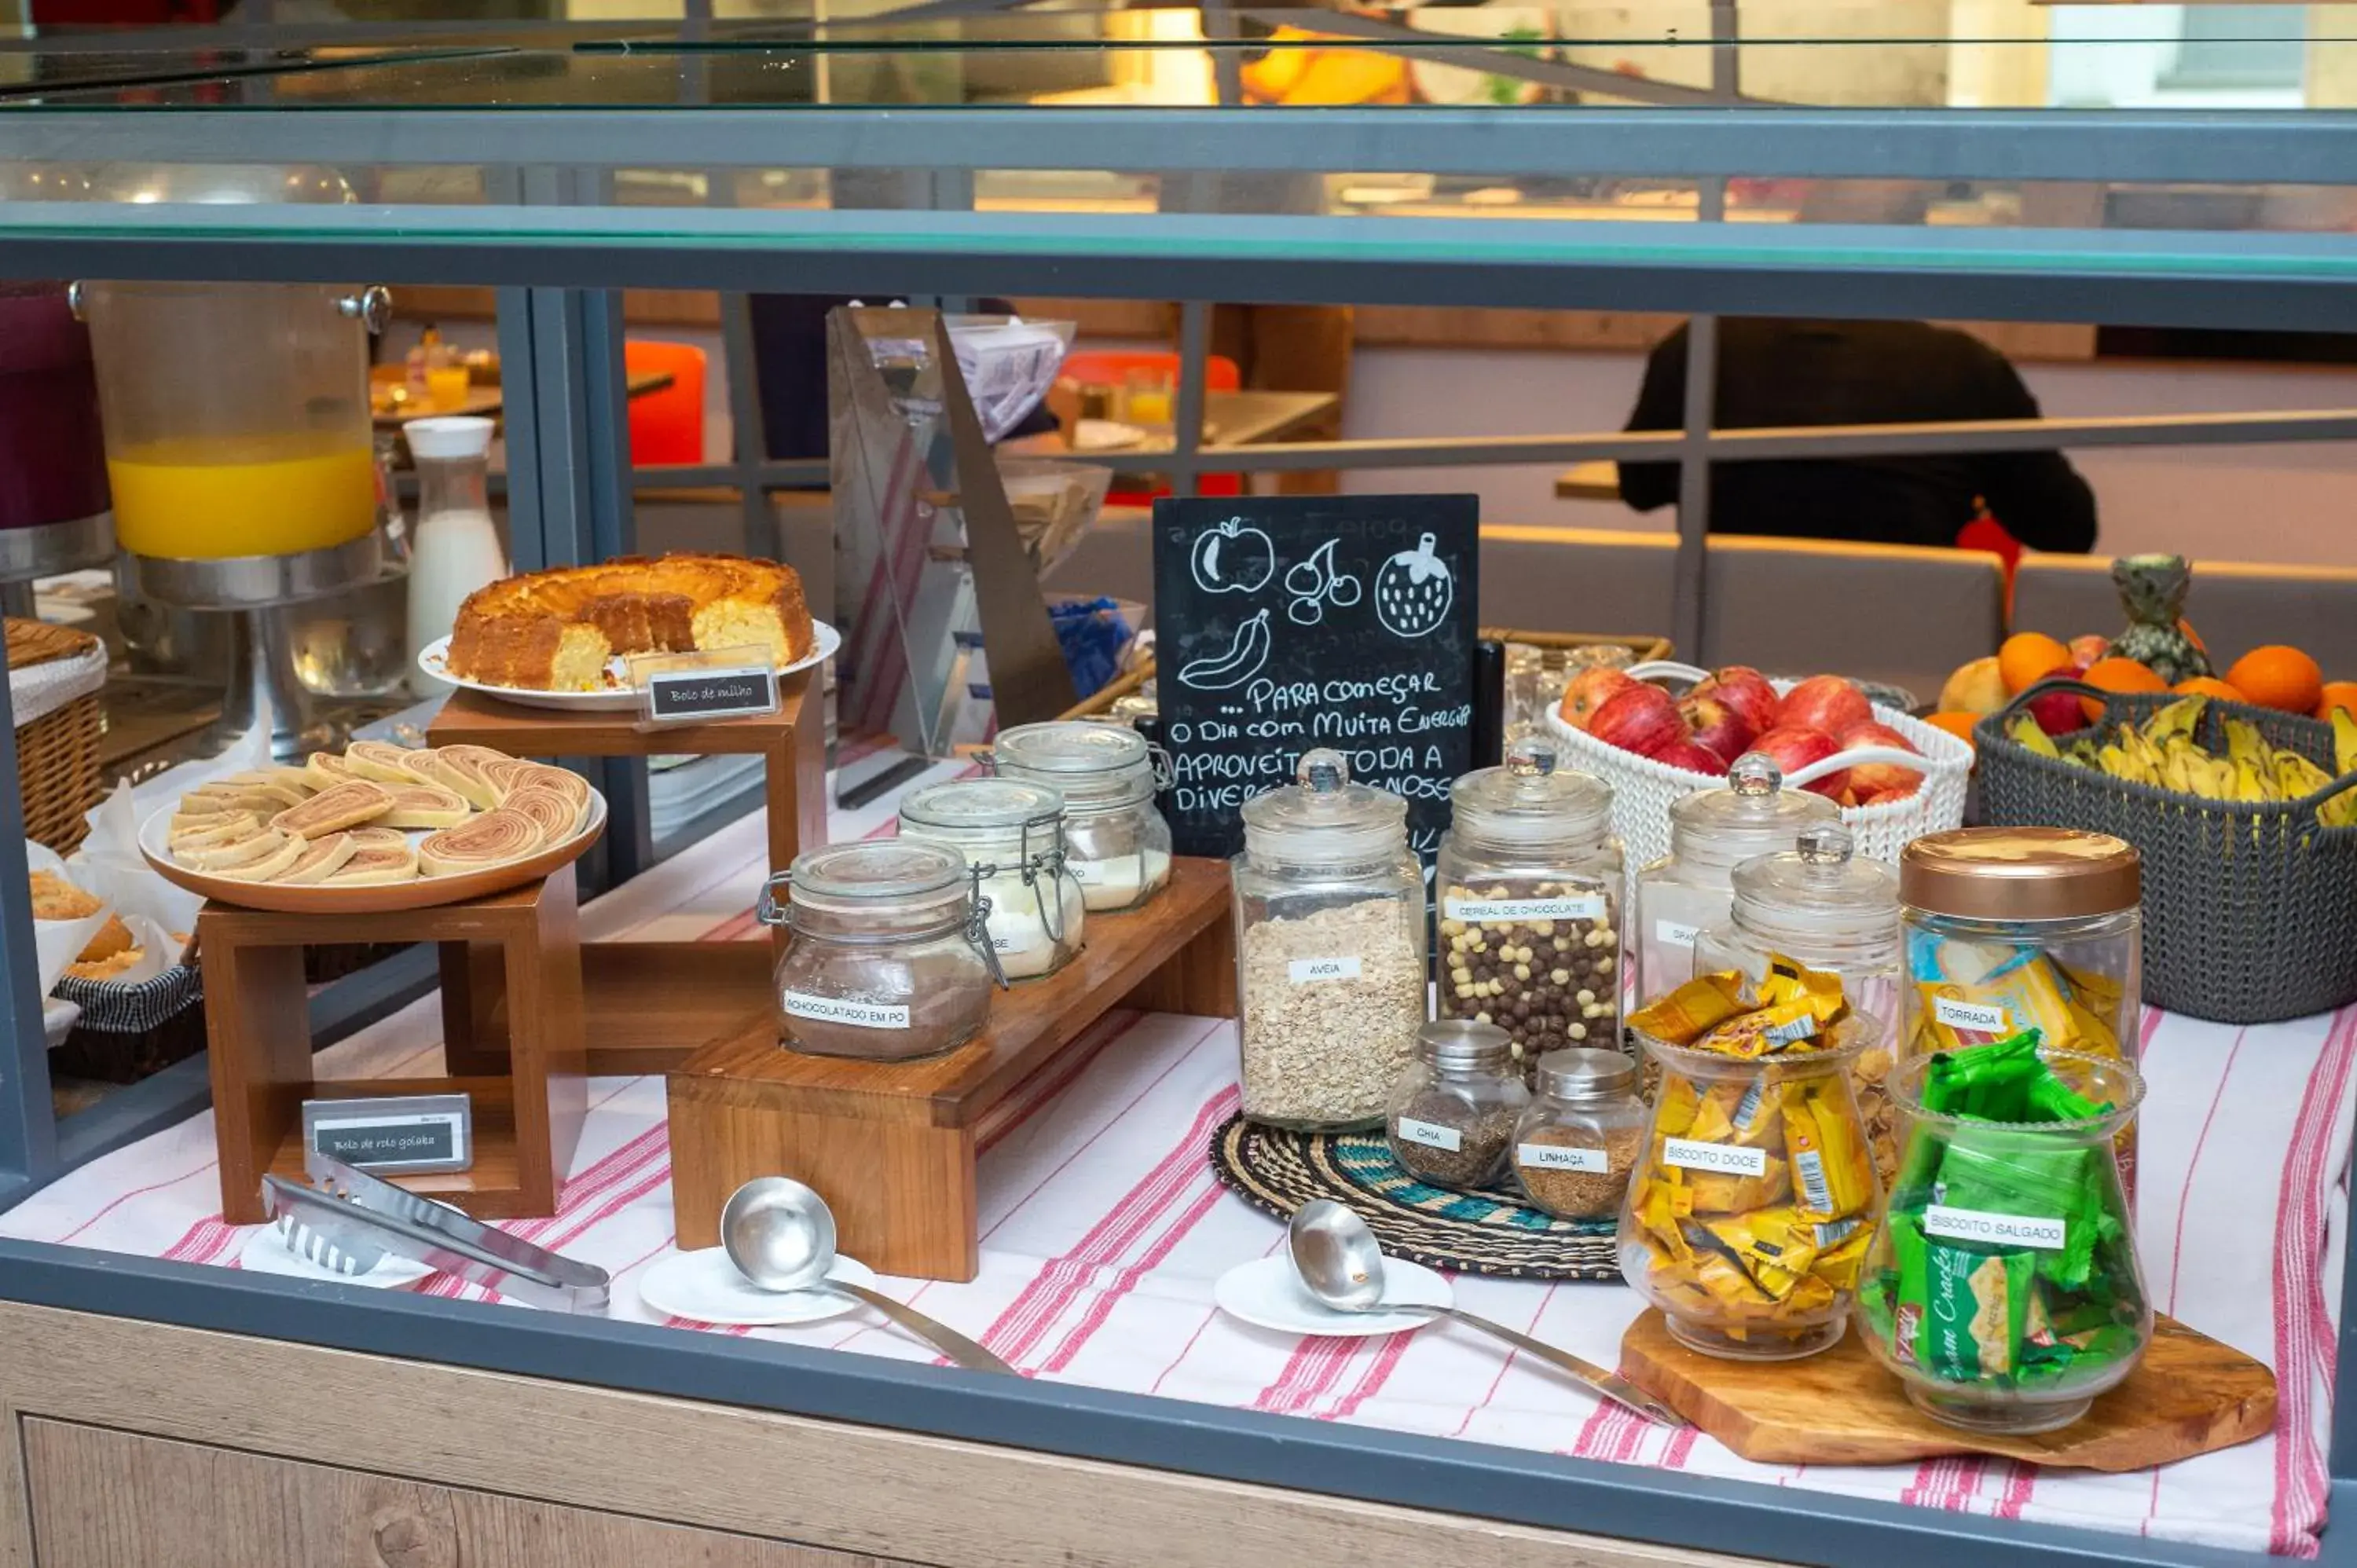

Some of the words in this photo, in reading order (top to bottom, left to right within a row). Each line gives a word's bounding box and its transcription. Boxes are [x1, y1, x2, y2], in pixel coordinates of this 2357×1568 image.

[670, 690, 698, 702] Bolo
[701, 687, 714, 700] de
[717, 684, 753, 698] milho
[1173, 747, 1301, 782] APROVEIT
[1424, 745, 1443, 769] A
[1459, 906, 1500, 917] CEREAL
[1502, 905, 1517, 915] DE
[1520, 903, 1585, 916] CHOCOLATE
[1310, 963, 1340, 975] AVEIA
[870, 1011, 885, 1022] EM
[1942, 1006, 1997, 1025] TORRADA
[1417, 1127, 1441, 1141] CHIA
[1668, 1145, 1718, 1163] BISCOITO
[1722, 1154, 1759, 1168] DOCE
[1930, 1214, 1991, 1233] BISCOITO
[1995, 1223, 2062, 1240] SALGADO
